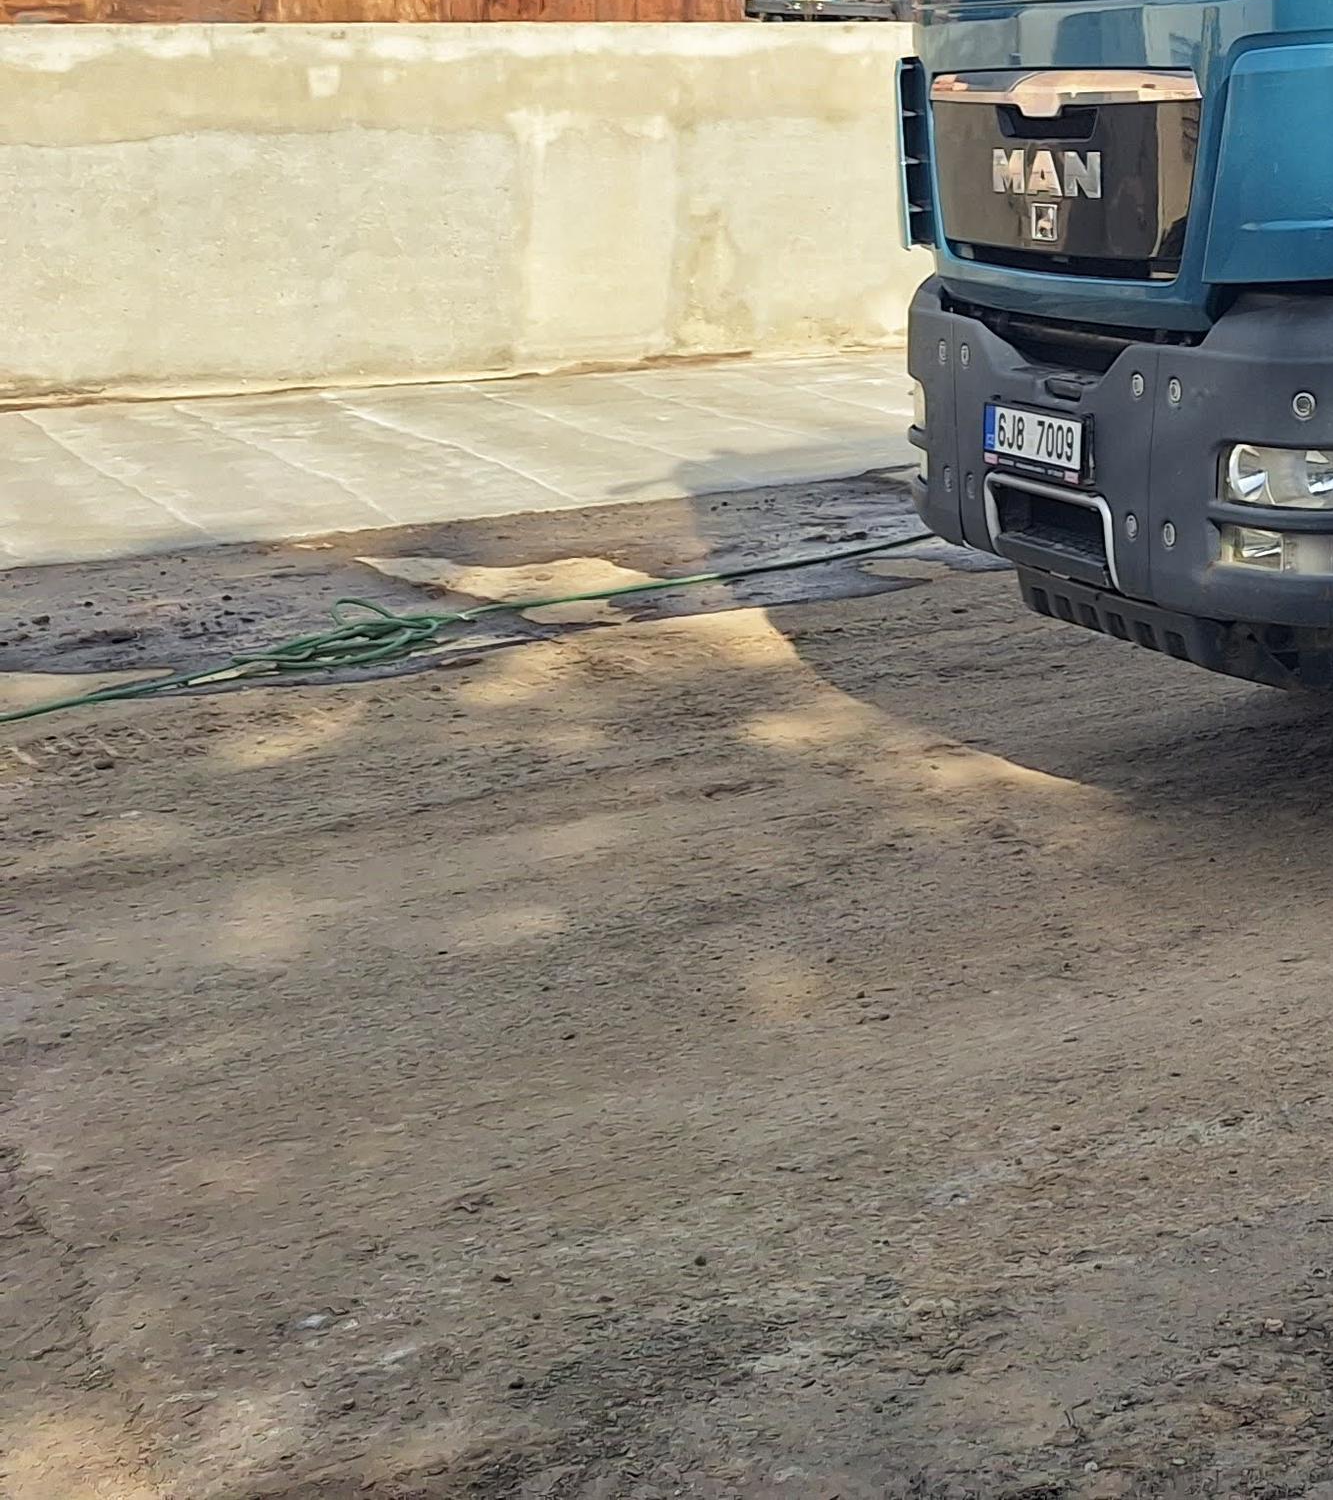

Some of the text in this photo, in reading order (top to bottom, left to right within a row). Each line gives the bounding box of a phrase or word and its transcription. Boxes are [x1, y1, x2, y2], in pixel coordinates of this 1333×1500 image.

[992, 148, 1102, 199] MAN
[998, 412, 1025, 451] 6J8
[1036, 420, 1074, 462] 7009
